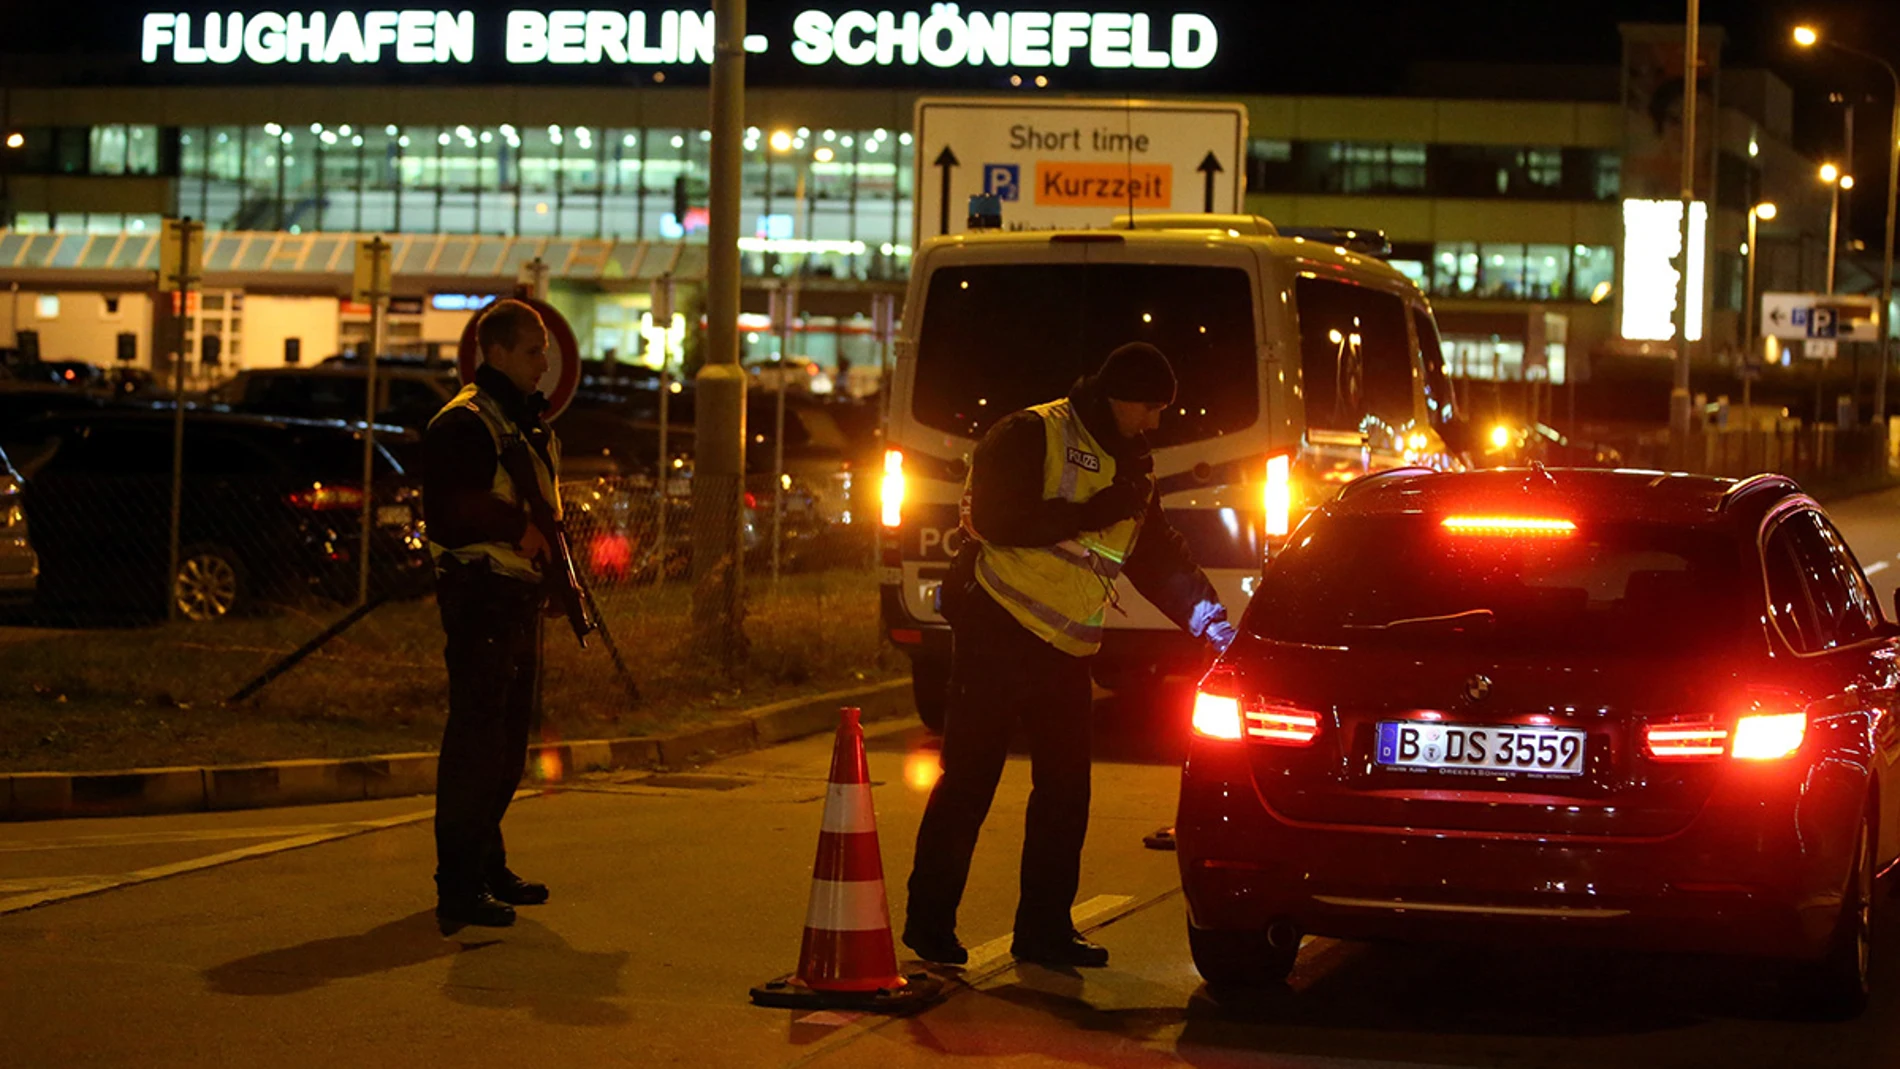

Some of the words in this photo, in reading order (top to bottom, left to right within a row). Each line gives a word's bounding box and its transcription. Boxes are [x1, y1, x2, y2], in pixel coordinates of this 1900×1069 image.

[142, 10, 475, 64] FLUGHAFEN
[506, 10, 715, 64] BERLIN
[791, 2, 1218, 68] SCHÖNEFELD
[1010, 123, 1081, 152] Short
[1092, 126, 1149, 152] time
[1043, 171, 1162, 198] Kurzzeit
[1068, 449, 1098, 471] POLIZEI
[1398, 728, 1420, 761] B
[1444, 730, 1487, 764] DS
[1495, 732, 1580, 768] 3559
